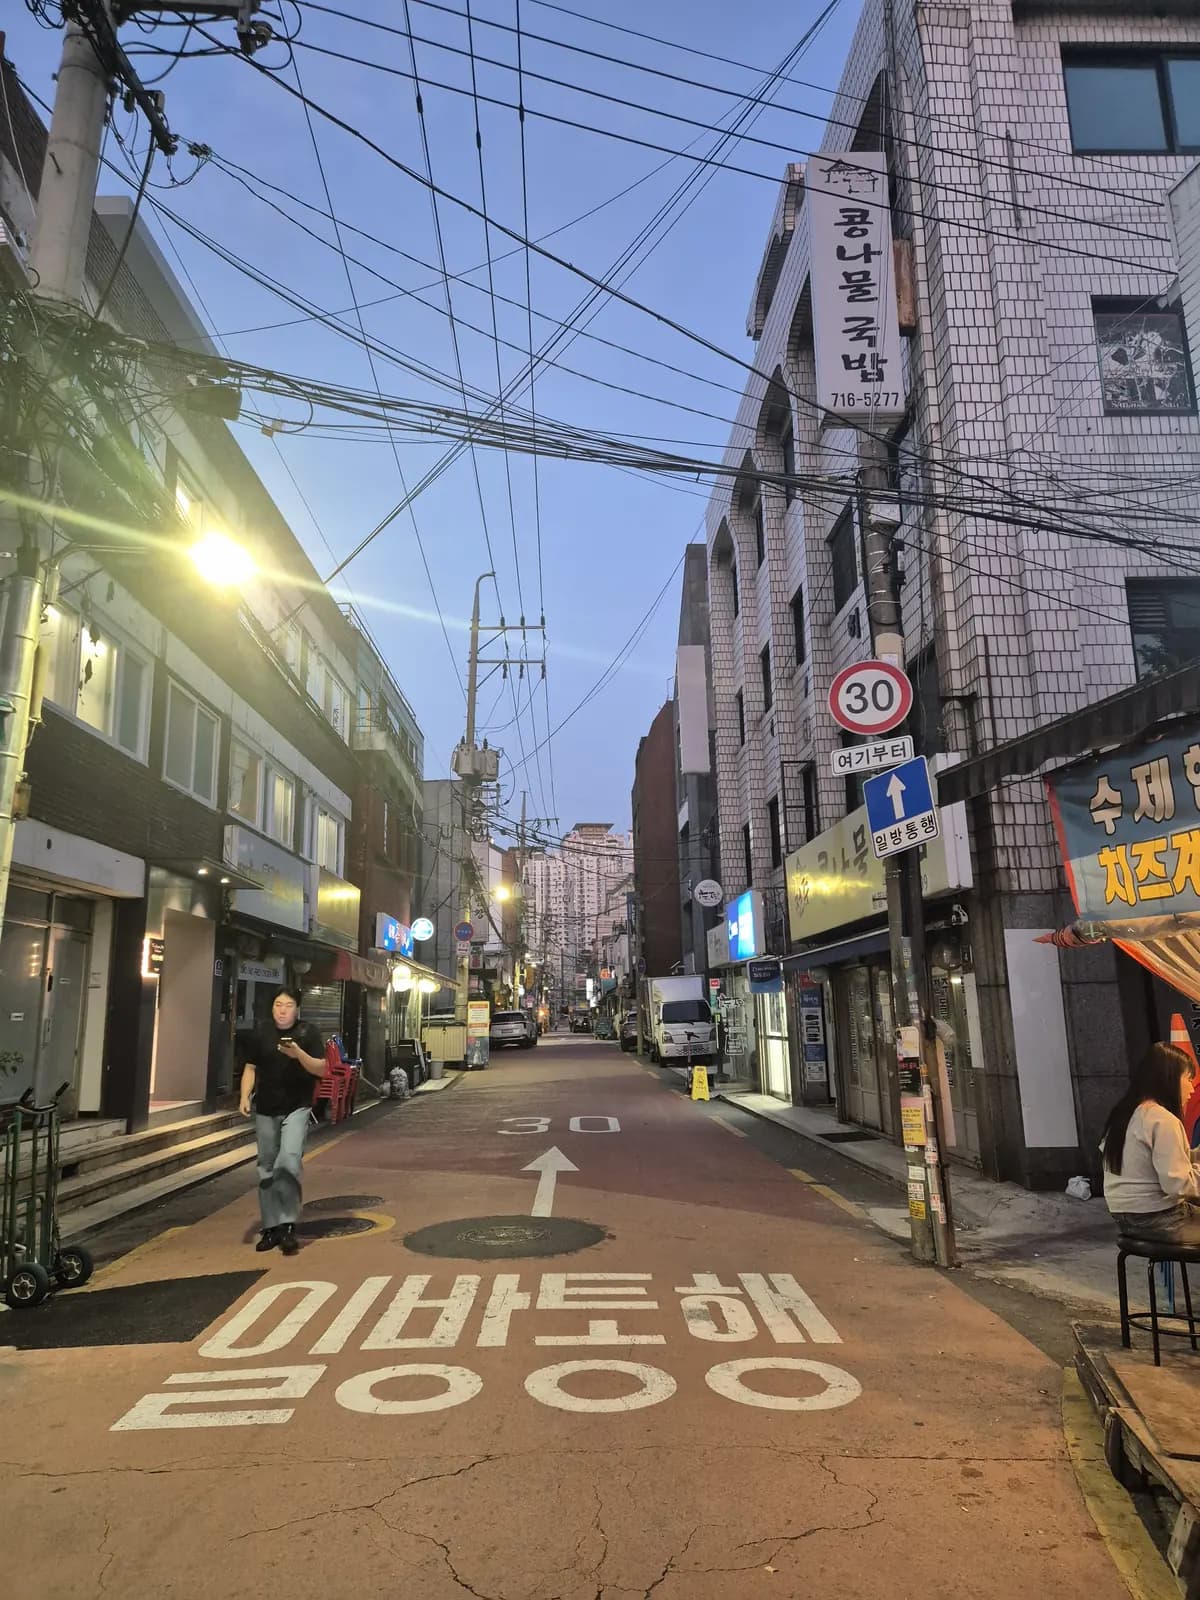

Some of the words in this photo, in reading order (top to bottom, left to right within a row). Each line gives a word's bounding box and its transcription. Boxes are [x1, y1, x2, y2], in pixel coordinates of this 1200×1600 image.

[834, 208, 882, 304] 콩나물
[841, 316, 888, 383] 국밥
[831, 392, 899, 408] 716-5277
[845, 679, 895, 715] 30
[838, 742, 907, 769] 여기부터
[874, 815, 936, 852] 일방통행
[499, 1114, 621, 1136] 30
